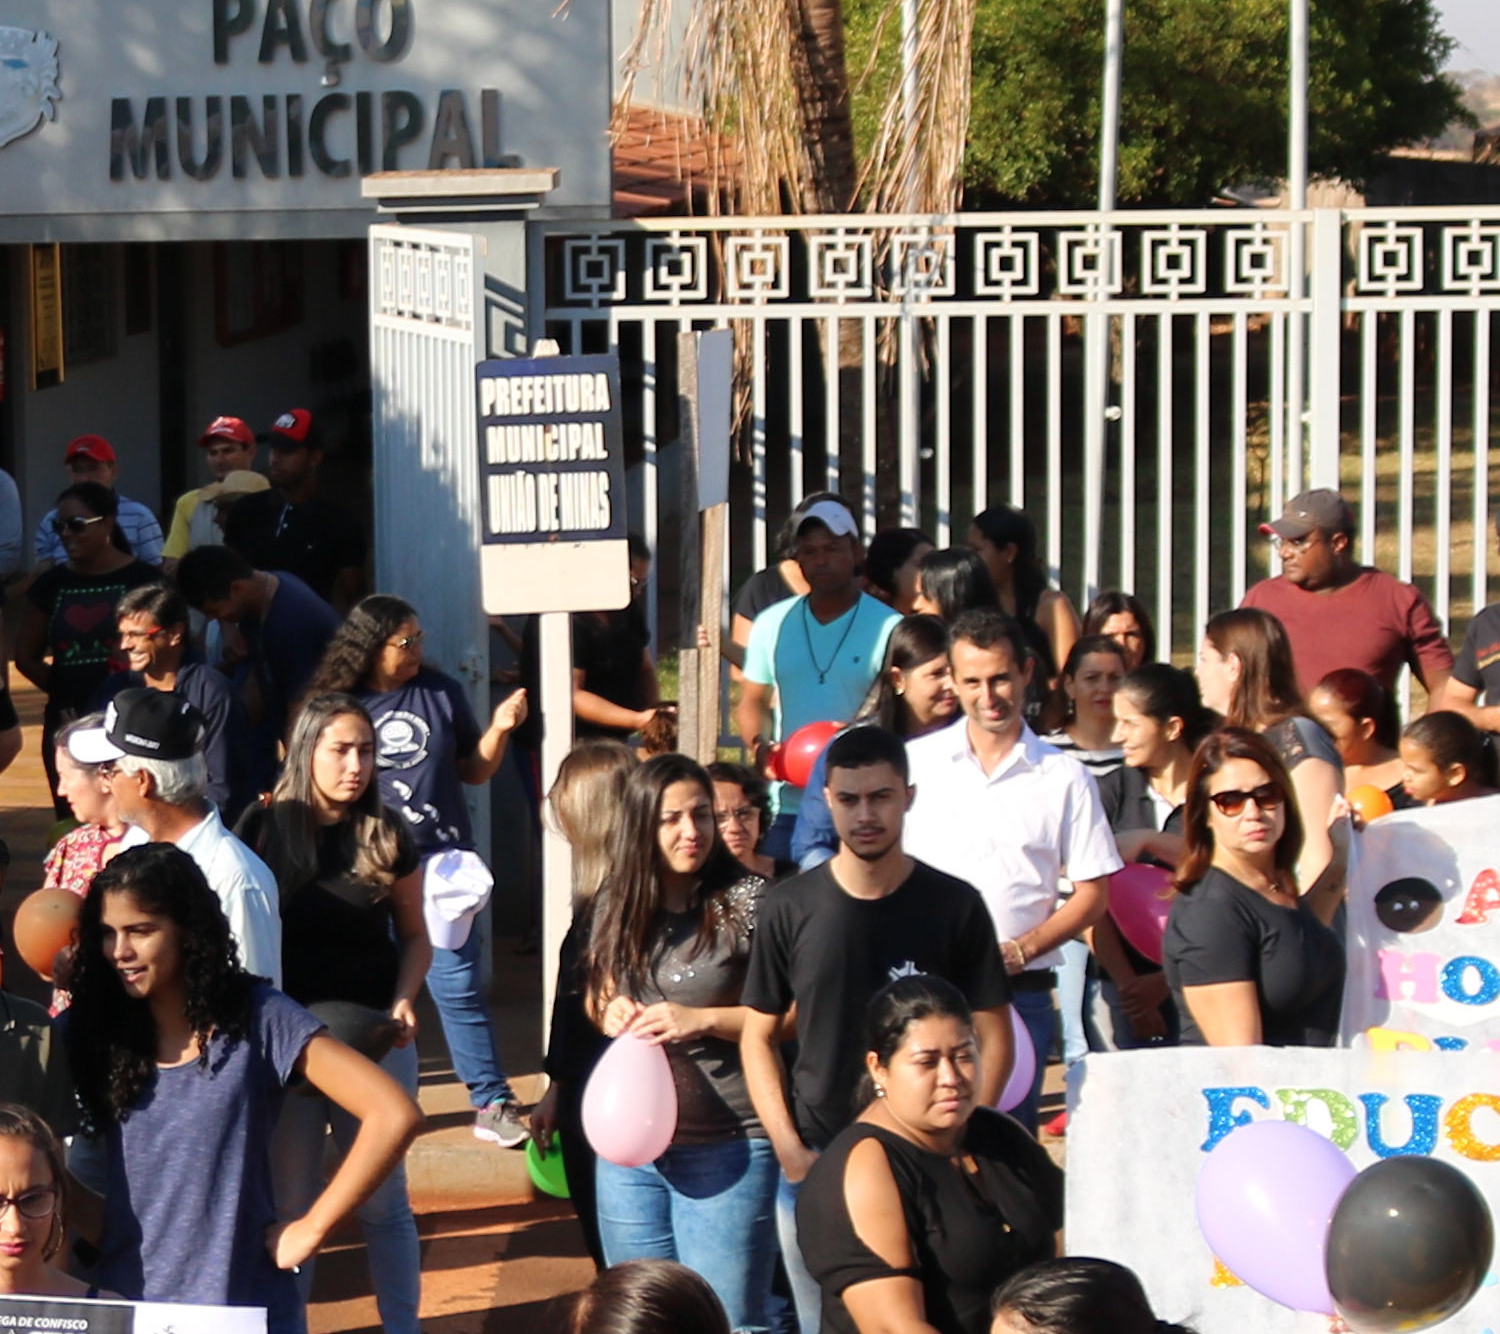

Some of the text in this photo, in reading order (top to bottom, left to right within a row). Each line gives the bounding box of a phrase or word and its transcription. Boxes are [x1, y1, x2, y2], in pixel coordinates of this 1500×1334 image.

[109, 87, 523, 182] MUNICIPAL
[480, 372, 612, 417] PREFEITURA
[486, 422, 610, 465] MUNICIPAL
[488, 470, 612, 534] UNIÃO DE MINAS
